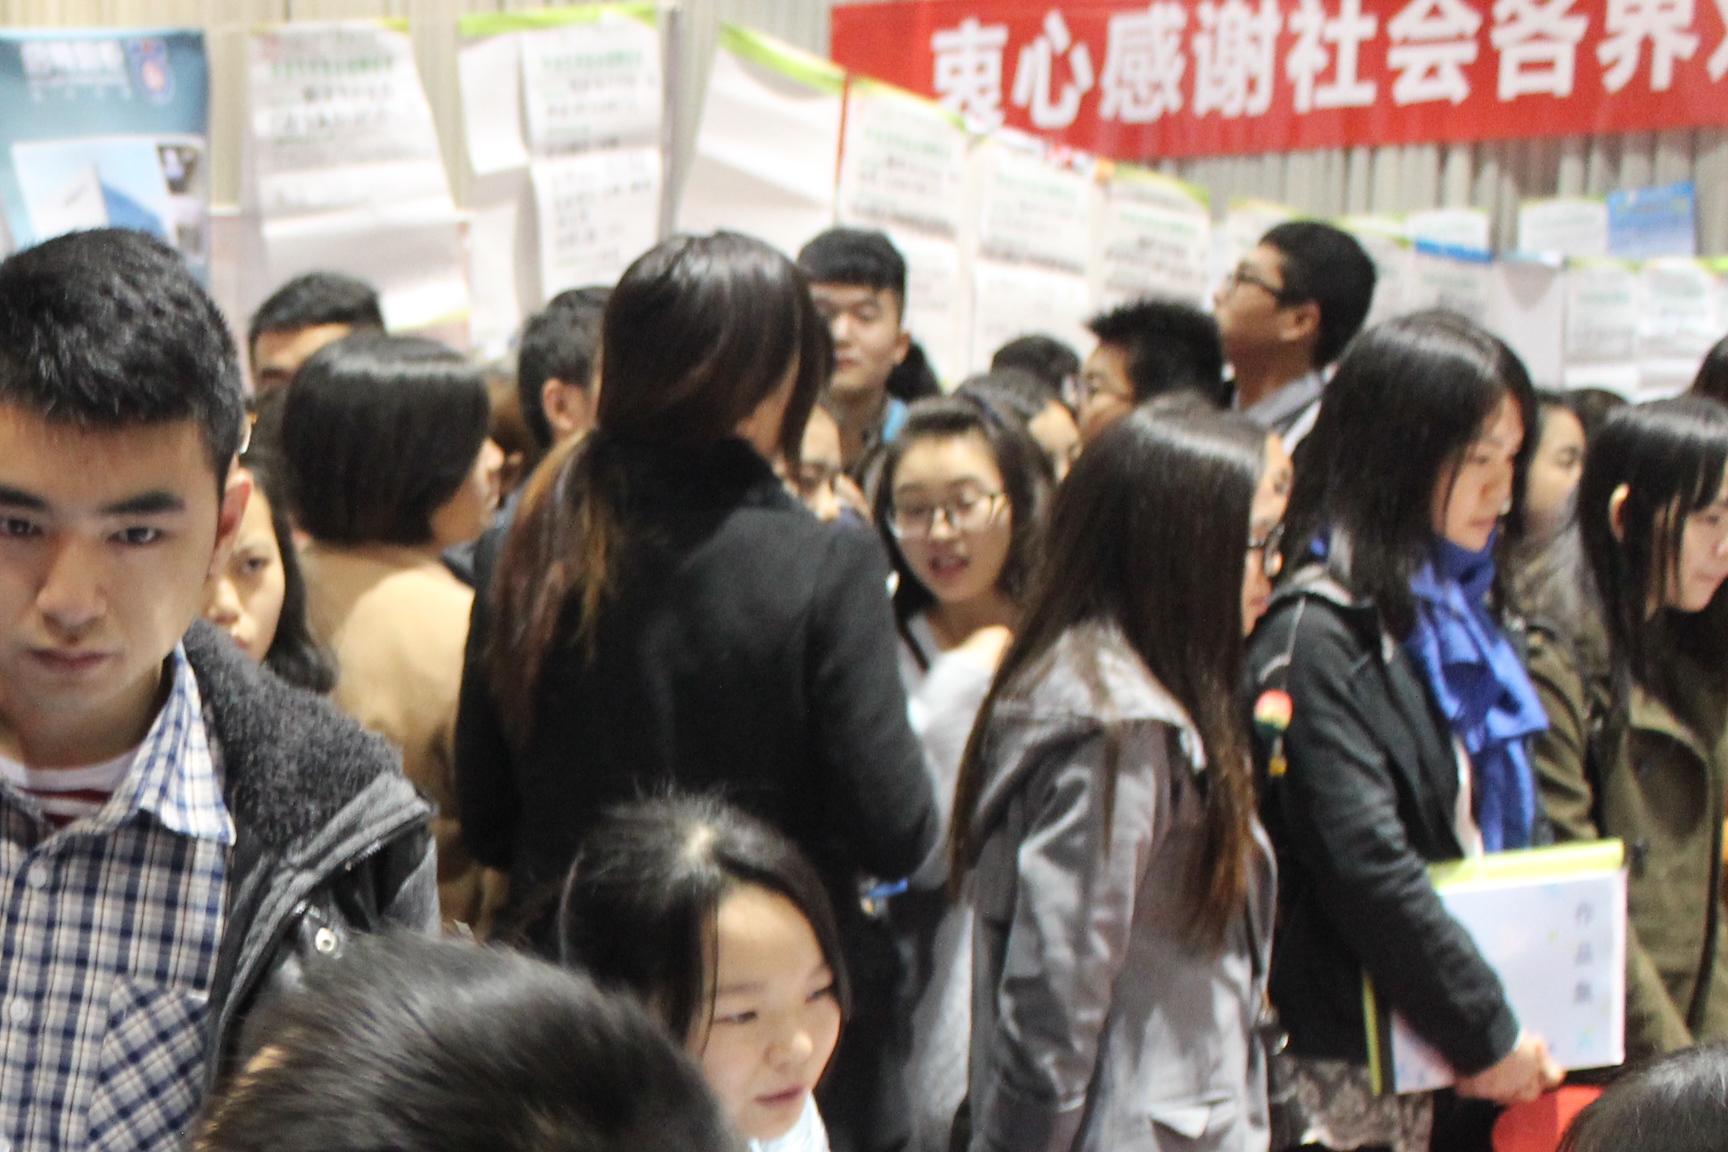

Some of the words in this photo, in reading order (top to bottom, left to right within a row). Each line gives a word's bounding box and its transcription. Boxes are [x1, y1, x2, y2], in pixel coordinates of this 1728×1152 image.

[931, 0, 1728, 130] 衷心感谢社会各界
